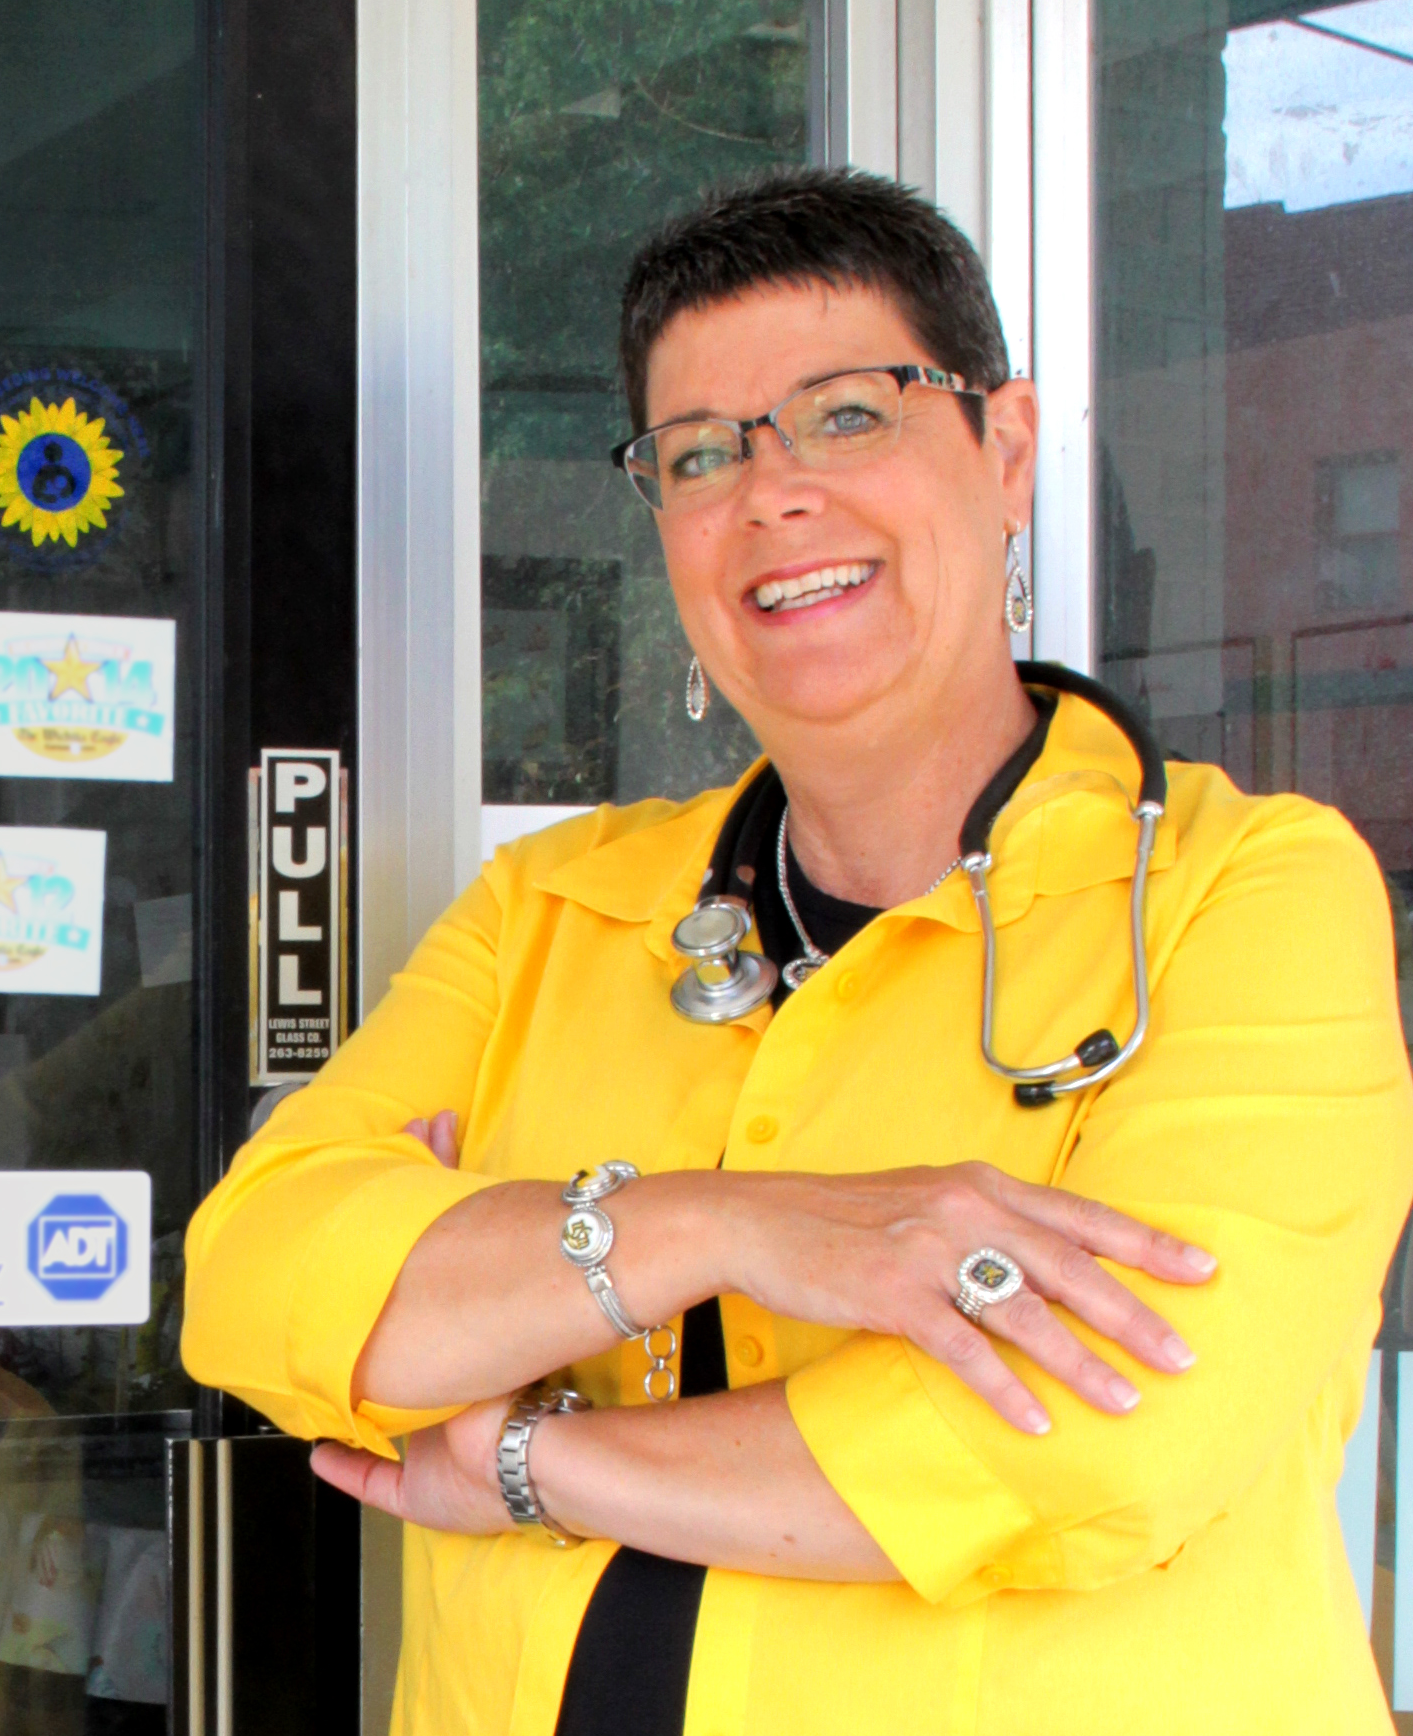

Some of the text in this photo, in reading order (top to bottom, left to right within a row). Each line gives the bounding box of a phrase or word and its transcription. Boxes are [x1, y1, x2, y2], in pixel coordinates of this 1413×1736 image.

[272, 762, 327, 1005] PULL
[268, 1018, 330, 1030] LEWIS STREET
[276, 1032, 305, 1044] GLASS
[41, 1226, 117, 1269] ADT
